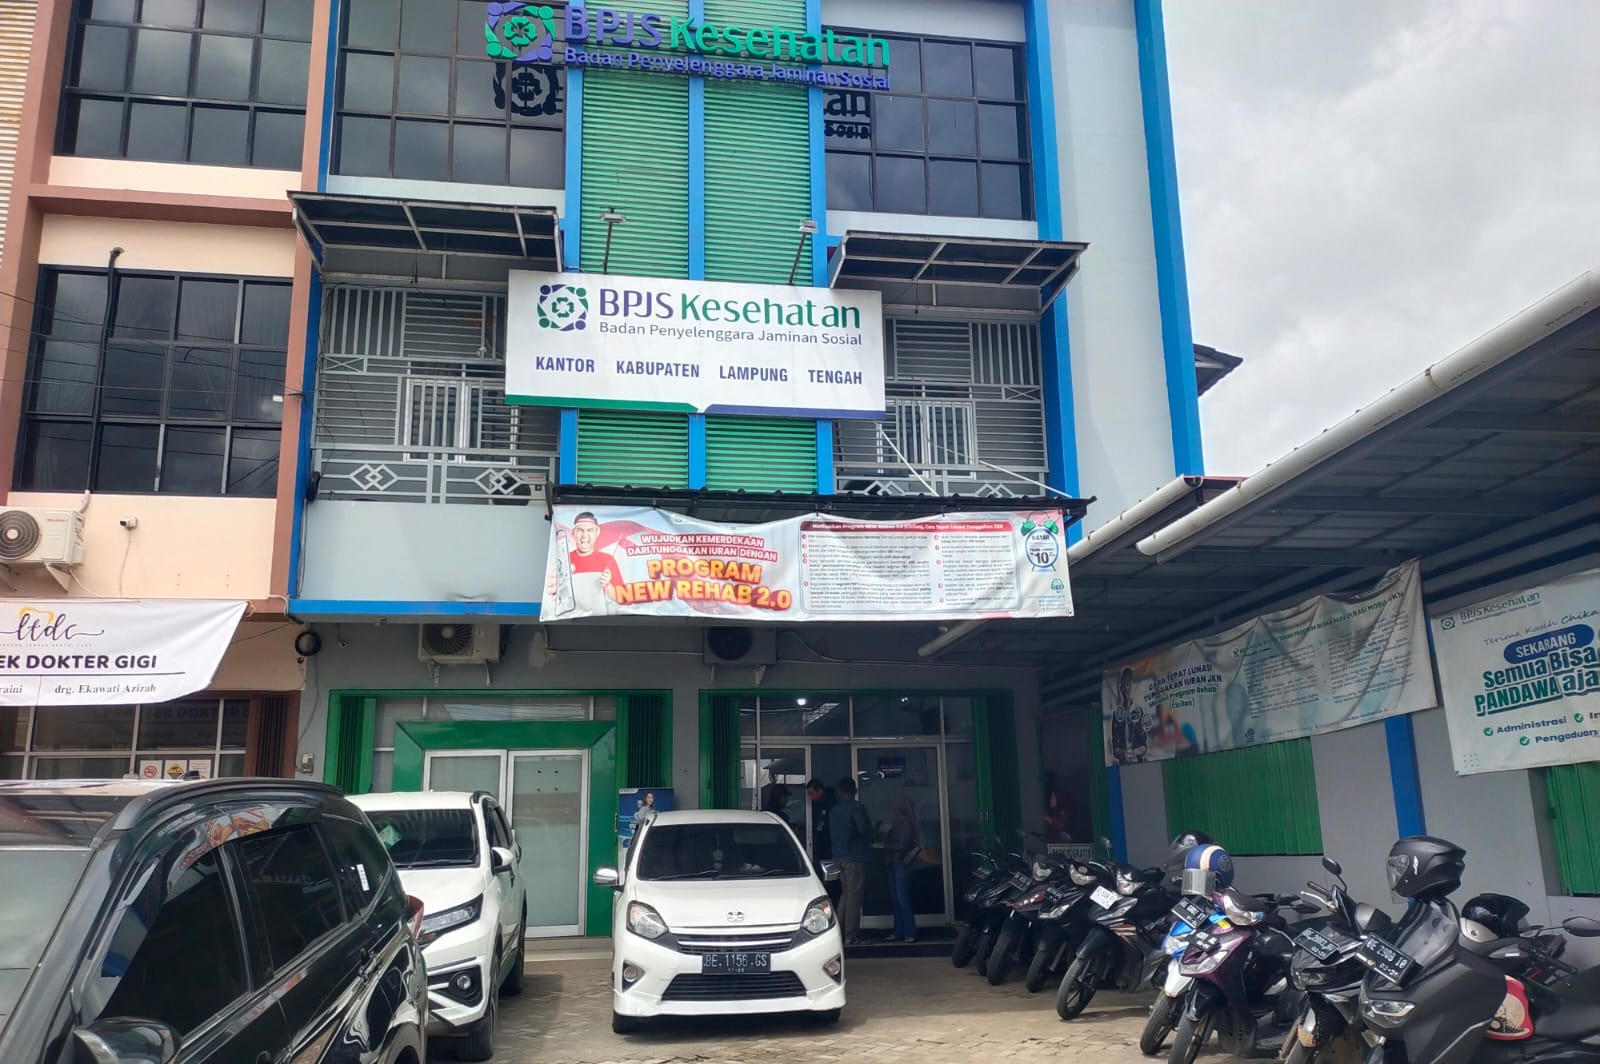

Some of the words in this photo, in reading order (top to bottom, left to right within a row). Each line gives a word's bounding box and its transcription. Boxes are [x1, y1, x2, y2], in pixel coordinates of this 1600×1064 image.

[565, 5, 661, 48] BPJS
[670, 15, 890, 67] Kesehatan
[565, 47, 623, 67] Badan
[628, 52, 763, 79] Penyelenggara
[769, 63, 837, 85] Jaminan
[840, 70, 890, 90] Sosial
[600, 288, 674, 320] BPJS
[682, 293, 861, 329] Kesehatan
[600, 321, 646, 335] Badan
[650, 323, 754, 342] Penyelenggara
[758, 329, 818, 344] Jaminan
[822, 332, 862, 346] Sosial
[536, 356, 595, 373] KANTOR
[616, 360, 700, 378] KABUPATEN
[719, 365, 788, 382] LAMPUNG
[808, 368, 862, 385] TENGAH
[641, 534, 694, 545] WUJUDKAN
[695, 536, 764, 547] KEMERDEKAAN
[627, 547, 650, 557] DARI
[651, 546, 707, 556] TUNGGAKAN
[708, 546, 737, 557] IURAN
[740, 549, 777, 562] DENGAN
[1035, 552, 1049, 564] 10
[647, 559, 762, 583] PROGRAM
[615, 580, 670, 604] NEW
[676, 580, 752, 605] REHAB
[755, 587, 792, 609] 2.0
[1460, 607, 1483, 621] BPJS
[1484, 592, 1540, 613] Kesehatan
[1484, 631, 1521, 646] Terima
[1525, 619, 1559, 635] Kasih
[1516, 632, 1577, 658] SEKARANG
[26, 655, 109, 669] DOKTER
[115, 655, 157, 668] GIGI
[1482, 658, 1548, 688] Semua
[1549, 646, 1597, 671] Bisa
[55, 685, 74, 695] drg.
[78, 685, 121, 694] Ekawati
[122, 684, 156, 693] Azizah
[1474, 676, 1561, 712] PANDAWA
[1563, 670, 1600, 692] aja
[1497, 715, 1567, 734] Administrasi
[1535, 730, 1597, 743] Pengaduan
